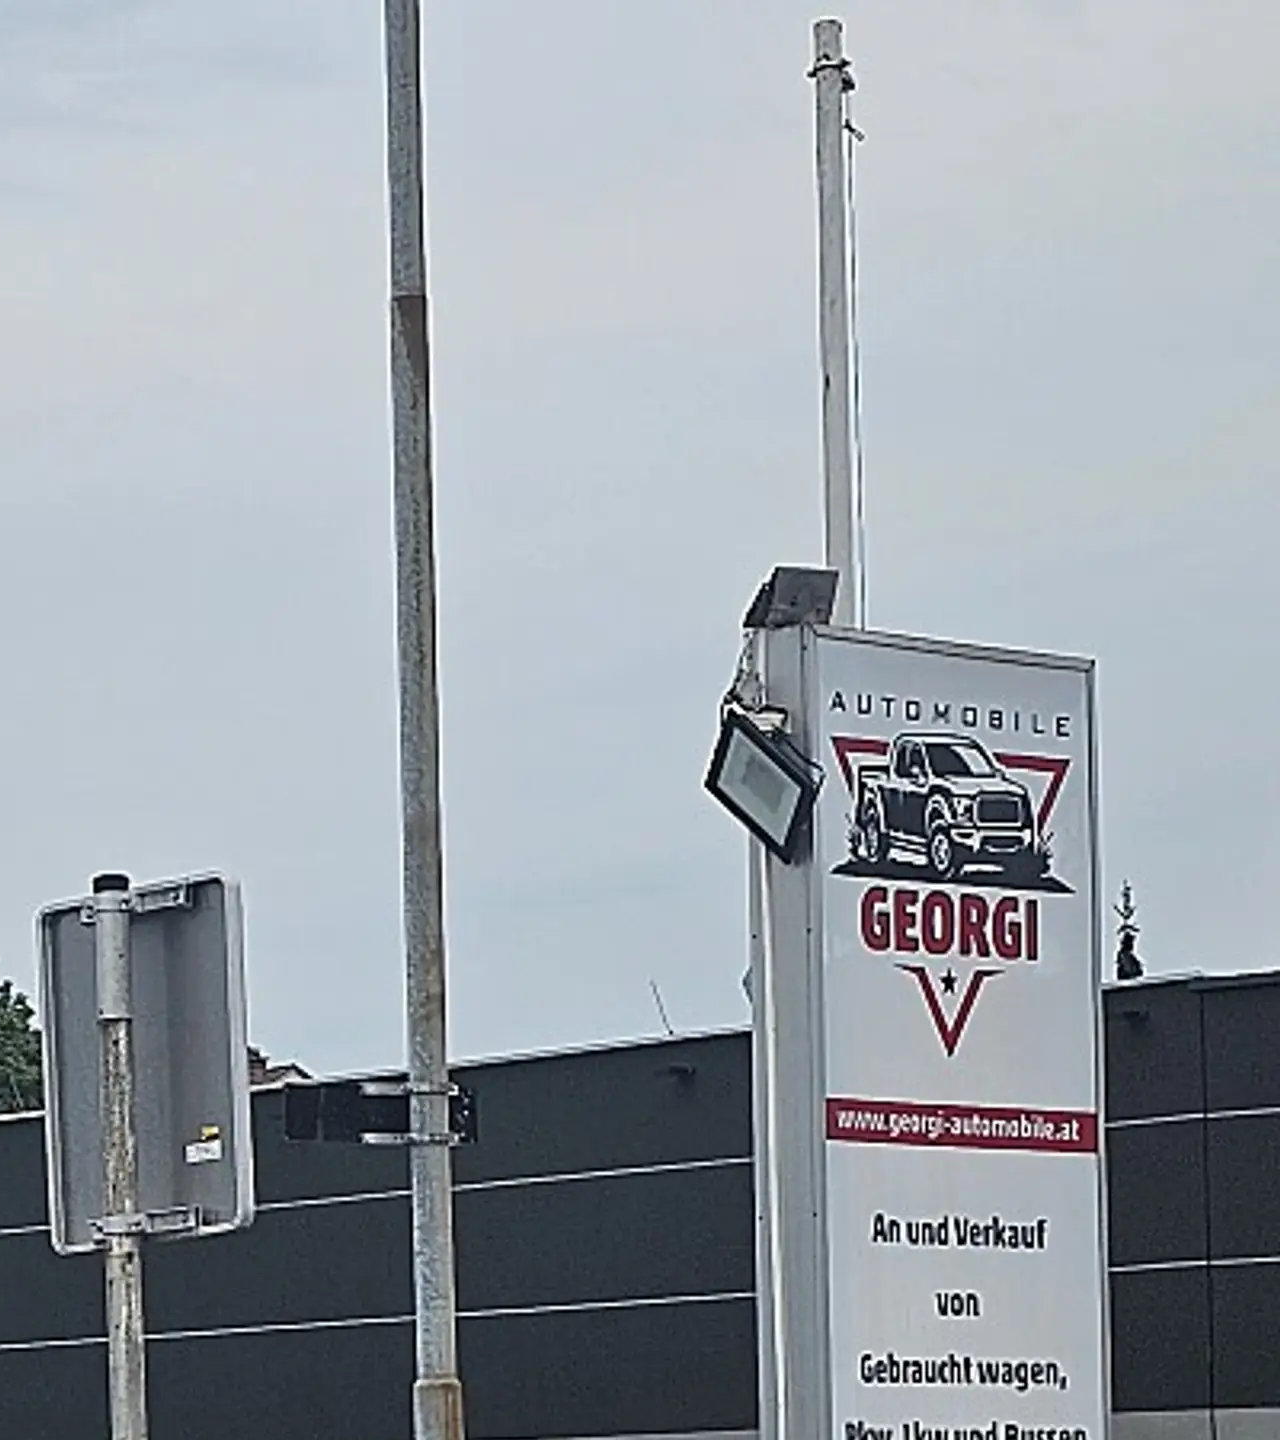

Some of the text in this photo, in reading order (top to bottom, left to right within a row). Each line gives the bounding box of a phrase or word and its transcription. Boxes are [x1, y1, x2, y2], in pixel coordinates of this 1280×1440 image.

[829, 691, 1072, 738] AUTOMOBILE
[860, 886, 1039, 961] GEORGI
[836, 1110, 1080, 1142] www.georgi-automobile.at
[872, 1214, 1048, 1249] An und Verkauf
[935, 1292, 981, 1317] von
